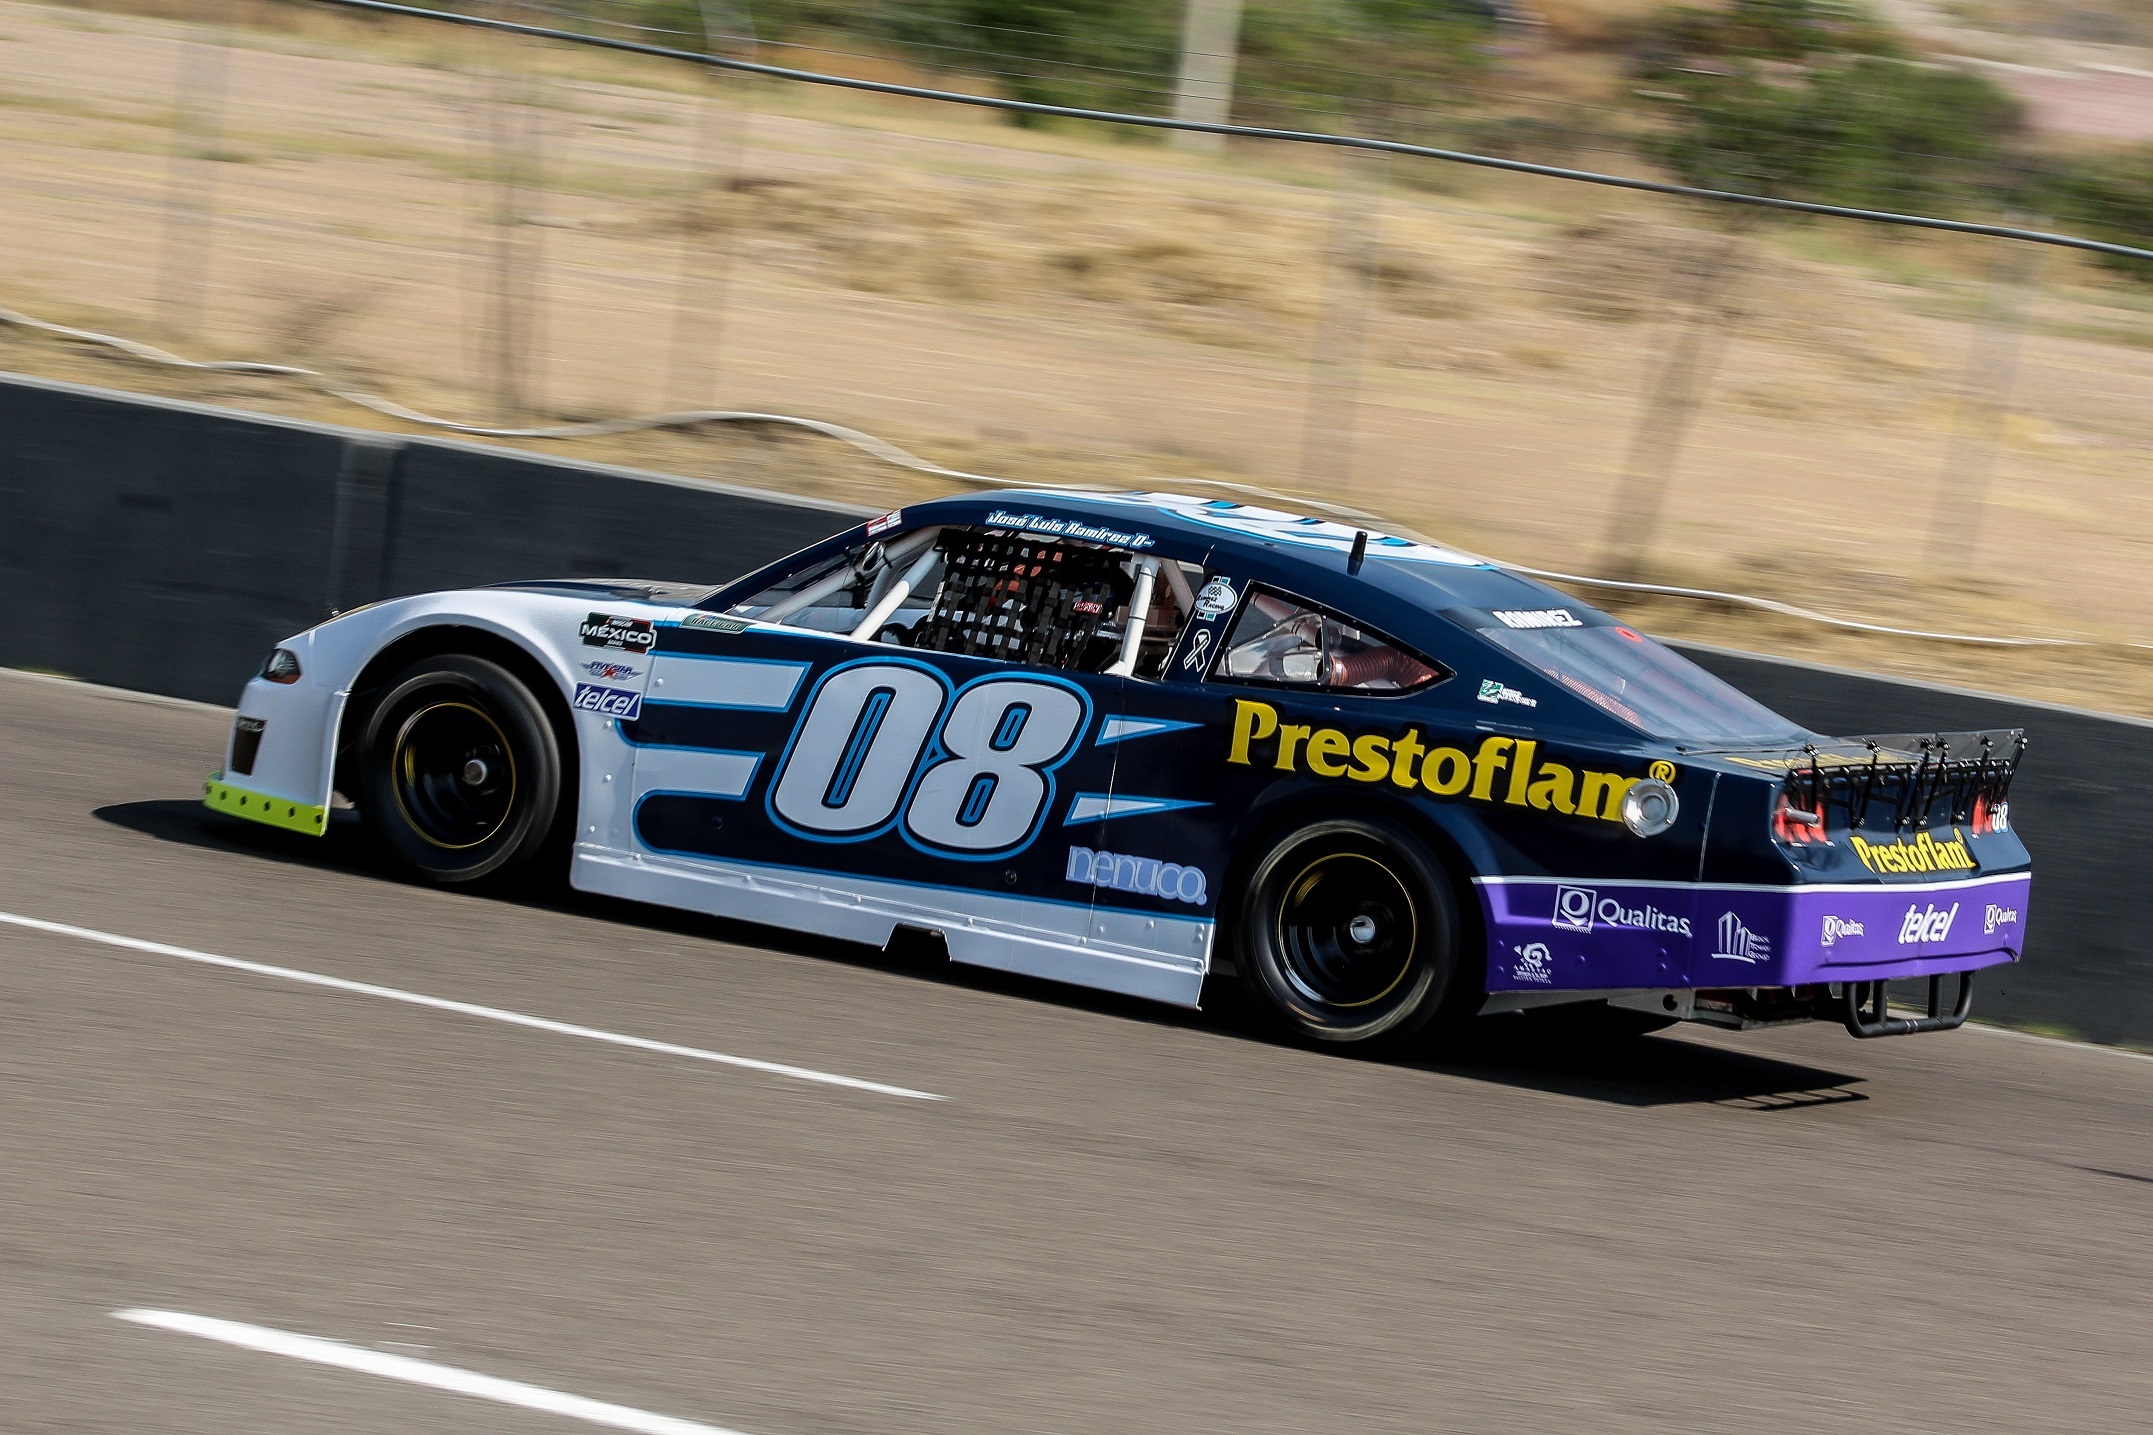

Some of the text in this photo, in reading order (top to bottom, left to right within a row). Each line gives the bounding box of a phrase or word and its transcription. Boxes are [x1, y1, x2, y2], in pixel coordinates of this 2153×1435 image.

[581, 622, 653, 645] MÉXICO
[1492, 609, 1583, 629] RAMIREZ
[575, 686, 640, 715] telcel
[772, 664, 1084, 853] 08
[1066, 846, 1207, 905] nenuco
[1598, 897, 1692, 938] Qualitas
[1898, 901, 1960, 944] telcel
